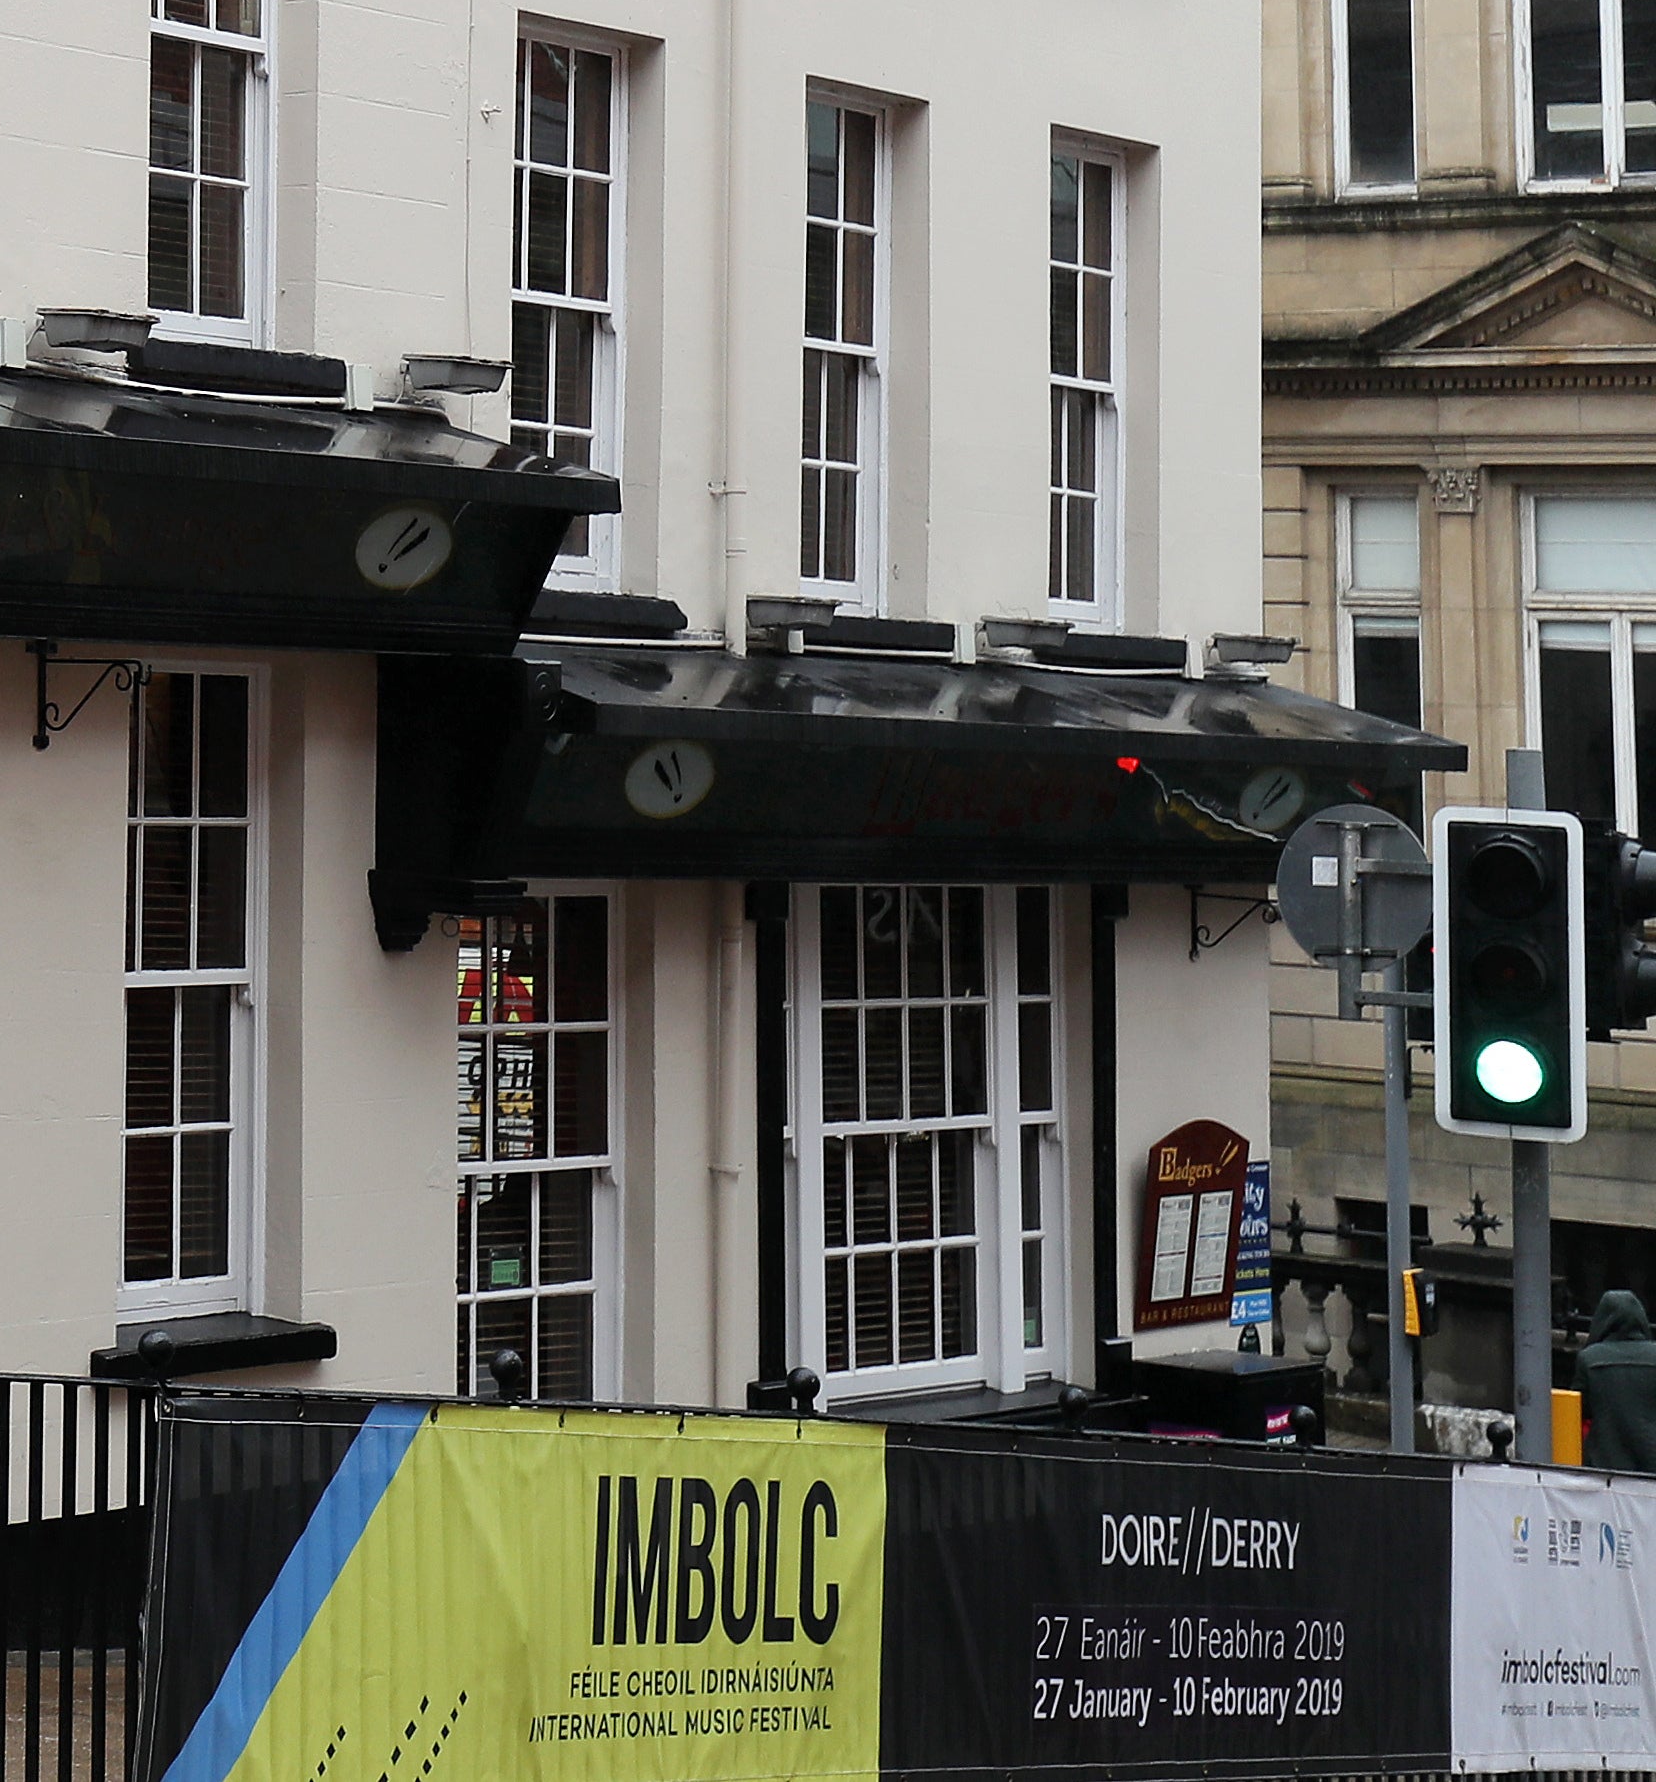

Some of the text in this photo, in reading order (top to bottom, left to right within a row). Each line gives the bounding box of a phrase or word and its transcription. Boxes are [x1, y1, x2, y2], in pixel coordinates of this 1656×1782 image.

[1159, 1148, 1212, 1187] Badgers
[1244, 1182, 1265, 1212] ity
[1141, 1310, 1159, 1324] BAR
[1172, 1302, 1230, 1319] RESTAURANT
[592, 1475, 839, 1645] IMBOLC
[1036, 1616, 1069, 1659] 27
[1080, 1618, 1147, 1660] Eanáir
[1169, 1616, 1193, 1659] 10
[1198, 1617, 1285, 1660] Feabhra
[1294, 1620, 1345, 1661] 2019
[570, 1659, 834, 1698] FÉILE CHEOIL IDIRNÁISIÚNTA
[1501, 1648, 1641, 1686] imbolcfestival.com
[1034, 1678, 1064, 1719] 27
[1069, 1679, 1153, 1727] January
[1173, 1676, 1195, 1716] 10
[1202, 1677, 1291, 1725] February
[1295, 1677, 1343, 1716] 2019
[529, 1706, 832, 1742] INTERNATIONAL MUSIC FESTIVAL
